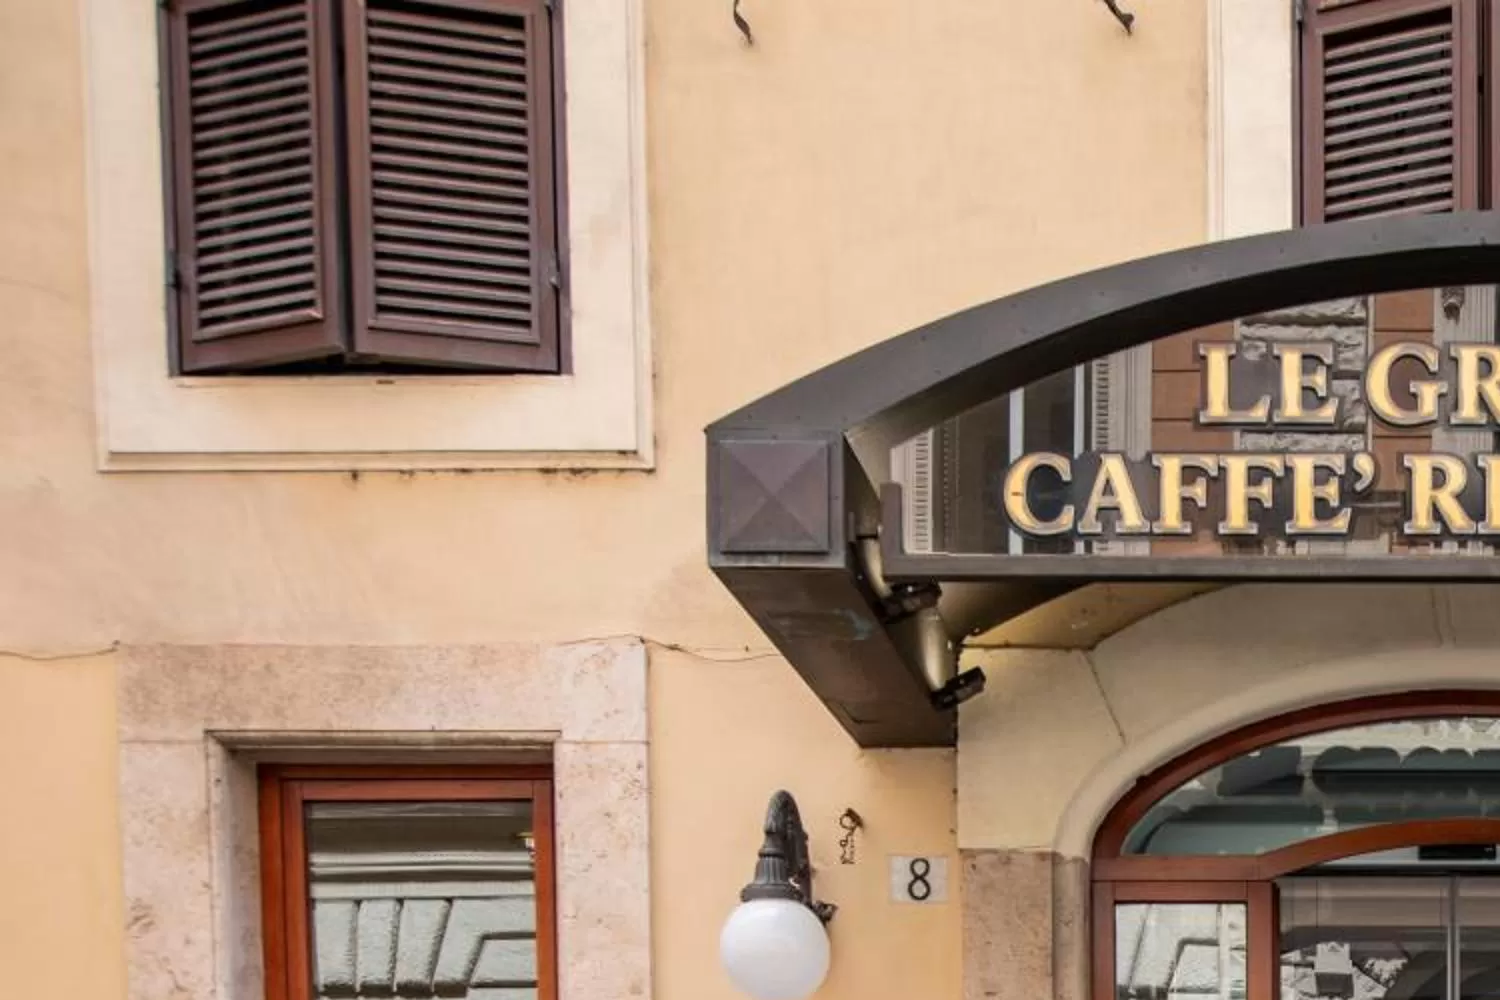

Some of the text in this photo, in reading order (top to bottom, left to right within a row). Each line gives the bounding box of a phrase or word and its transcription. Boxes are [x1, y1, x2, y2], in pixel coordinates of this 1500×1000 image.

[1198, 340, 1340, 426] LE
[1003, 451, 1376, 536] CAFFE'
[907, 857, 931, 901] 8
